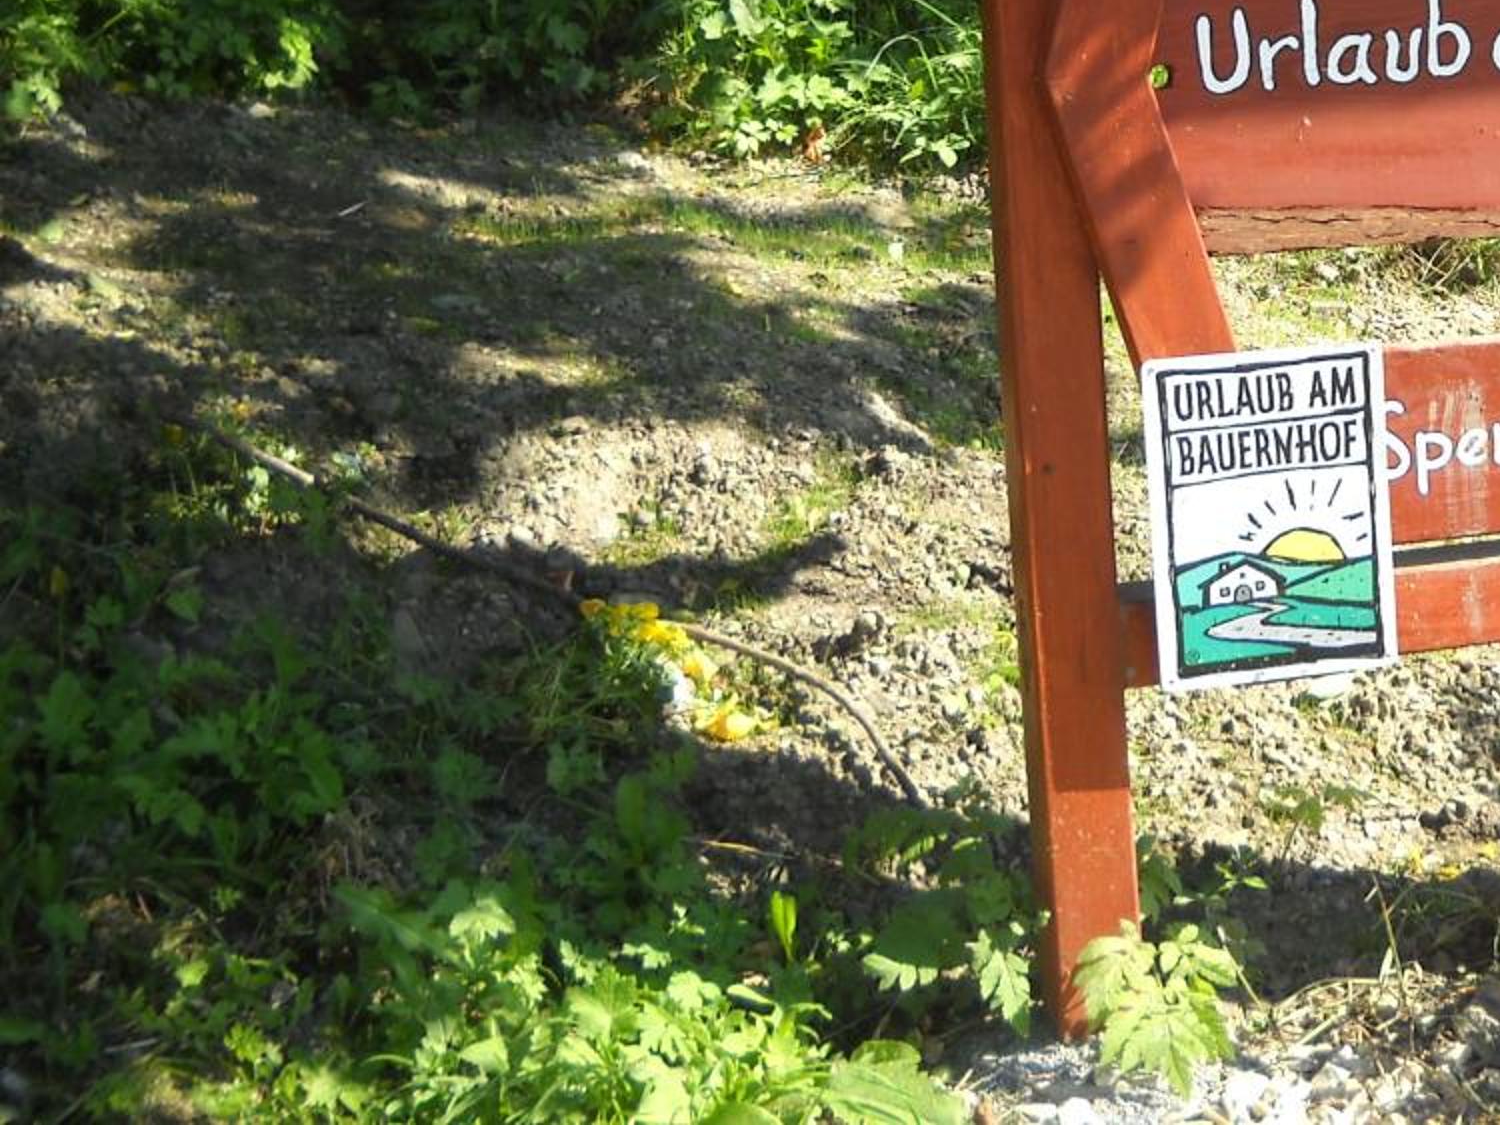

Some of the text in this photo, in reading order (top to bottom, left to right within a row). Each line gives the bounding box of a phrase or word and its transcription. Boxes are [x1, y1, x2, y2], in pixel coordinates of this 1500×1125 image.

[1173, 366, 1357, 422] URLAUB AM
[1176, 419, 1359, 477] BAUERNHOF
